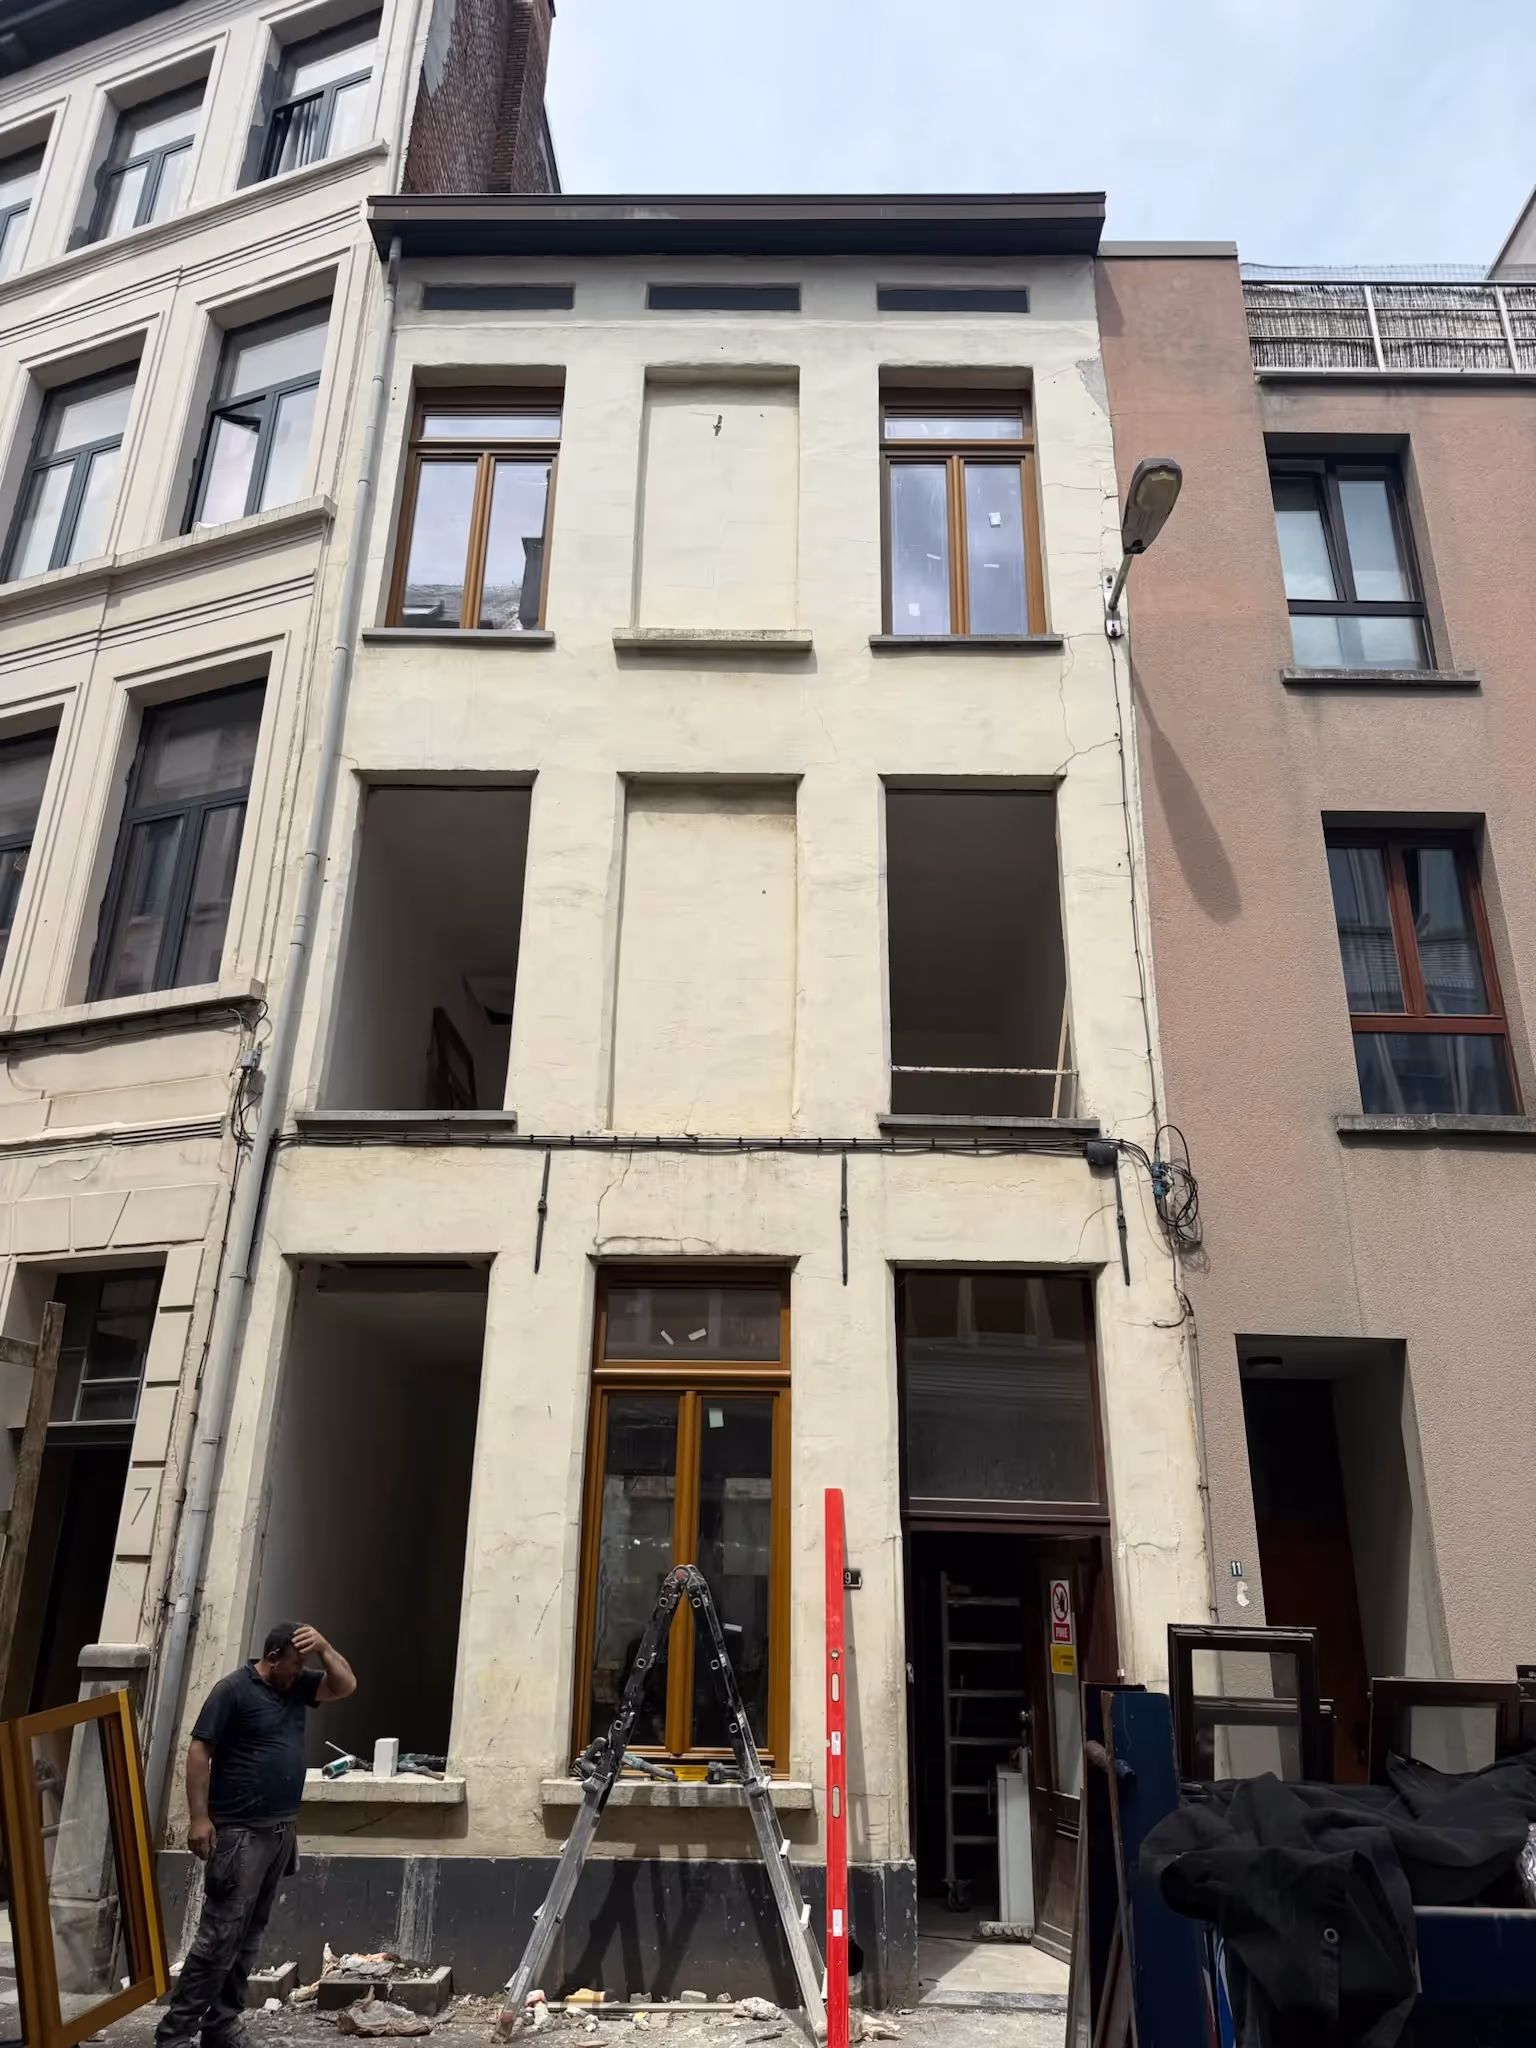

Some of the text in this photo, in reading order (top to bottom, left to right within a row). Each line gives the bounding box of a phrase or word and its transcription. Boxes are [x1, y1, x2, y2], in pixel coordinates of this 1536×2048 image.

[130, 1486, 152, 1526] 7
[1231, 1561, 1242, 1576] 11
[844, 1571, 852, 1584] 9
